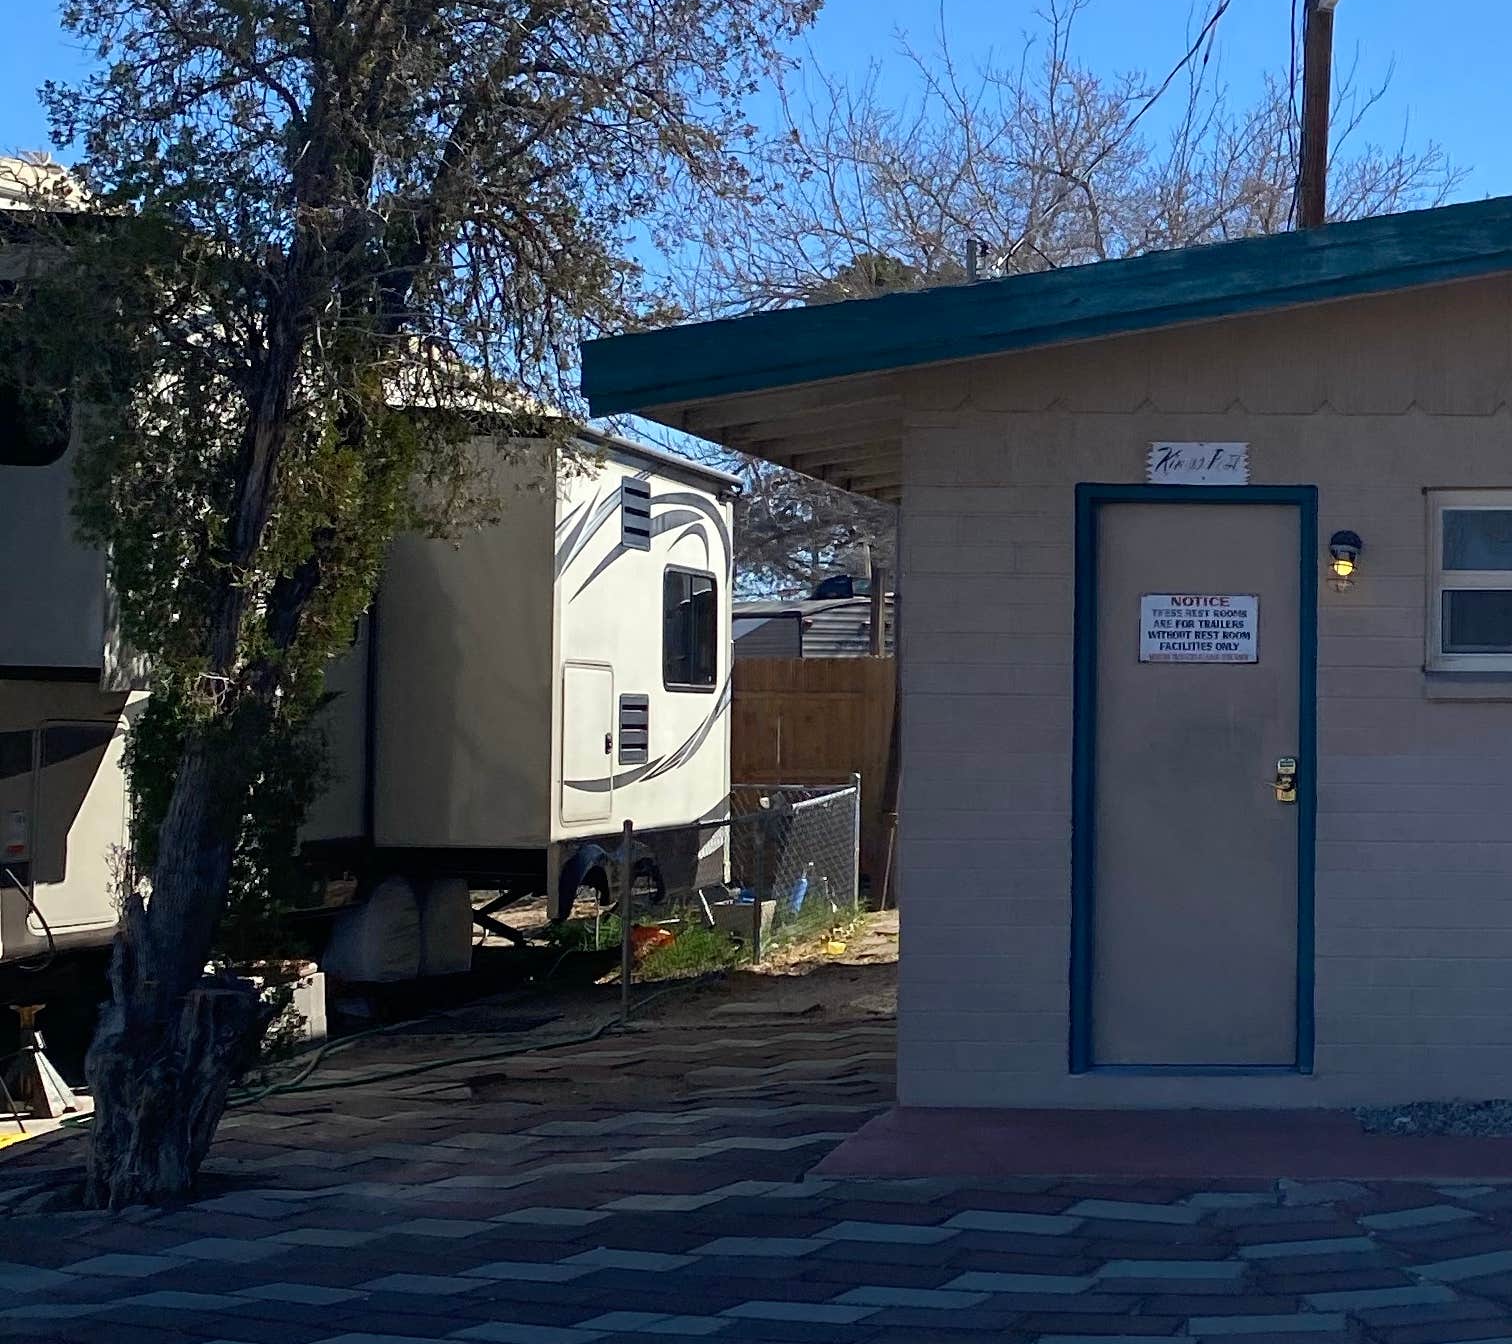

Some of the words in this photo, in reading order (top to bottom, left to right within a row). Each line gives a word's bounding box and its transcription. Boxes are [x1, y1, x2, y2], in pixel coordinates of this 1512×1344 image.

[1171, 596, 1231, 607] NOTICE
[1152, 608, 1184, 618] THESE
[1185, 609, 1211, 618] REST
[1213, 609, 1248, 618] ROOMS
[1153, 619, 1173, 629] ARE
[1175, 619, 1195, 629] FOR
[1199, 620, 1244, 629] TRAILERS
[1147, 630, 1193, 640] WITHOUT
[1194, 630, 1219, 640] REST
[1222, 631, 1251, 640] ROOM
[1159, 641, 1212, 651] FACILITIES
[1215, 642, 1240, 651] ONLY
